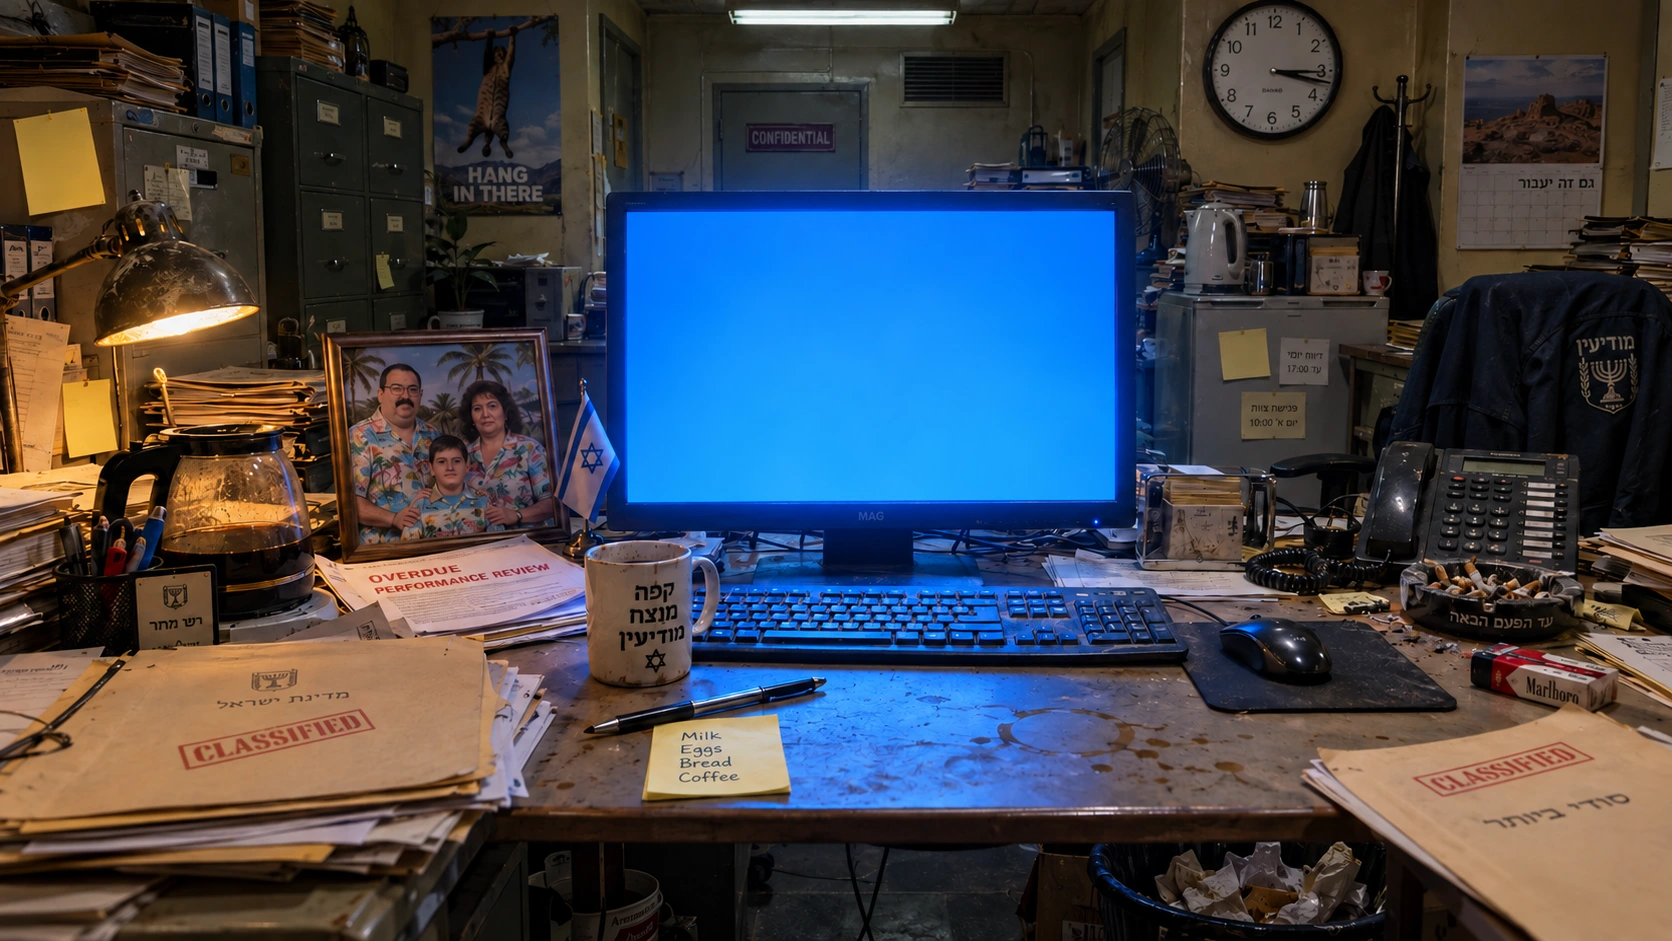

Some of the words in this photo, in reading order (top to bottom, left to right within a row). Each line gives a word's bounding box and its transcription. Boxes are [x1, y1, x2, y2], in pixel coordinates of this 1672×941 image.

[1245, 22, 1256, 36] 11
[1268, 15, 1282, 29] 12
[1296, 22, 1301, 36] 1
[1227, 40, 1242, 54] 10
[1310, 39, 1320, 53] 2
[1220, 64, 1230, 77] 9
[1316, 64, 1326, 78] 3
[1226, 88, 1236, 103] 8
[1307, 88, 1318, 101] 4
[1245, 105, 1254, 118] 7
[1267, 111, 1277, 125] 6
[1291, 105, 1300, 118] 5
[752, 130, 830, 145] CONFIDENTIAL
[468, 166, 528, 184] HANG
[1518, 178, 1553, 190] יעבור
[1558, 178, 1574, 189] זה
[1578, 178, 1595, 189] גם
[453, 185, 475, 202] IN
[479, 185, 544, 202] THERE
[1575, 335, 1636, 357] מודיעין
[1287, 351, 1302, 359] יומי
[1287, 364, 1309, 373] 17:00
[1311, 366, 1322, 374] עד
[1250, 404, 1269, 413] צוות
[1249, 418, 1273, 427] 10:00
[1286, 419, 1298, 427] יום
[858, 511, 884, 521] MAG
[368, 564, 462, 584] OVERDUE
[374, 572, 489, 595] PERFORMANCE
[492, 563, 550, 578] REVIEW
[634, 582, 674, 603] קפה
[630, 604, 678, 624] מנצח
[1449, 610, 1489, 628] הבאה
[149, 619, 179, 631] מחר
[182, 616, 203, 628] רש
[1493, 617, 1532, 630] הפעם
[1537, 616, 1554, 628] עד
[618, 625, 685, 651] מודיעין
[288, 690, 350, 704] מדינת
[1526, 676, 1579, 705] Marlboro
[216, 697, 280, 710] ישראל
[192, 713, 363, 763] CLASSIFIED
[681, 731, 722, 741] Milk
[680, 744, 722, 758] Eggs
[679, 756, 732, 769] Bread
[1430, 747, 1577, 792] CLASSIFIED
[678, 770, 740, 783] Coffee
[1567, 792, 1631, 810] סודי
[1482, 807, 1566, 829] ביותר
